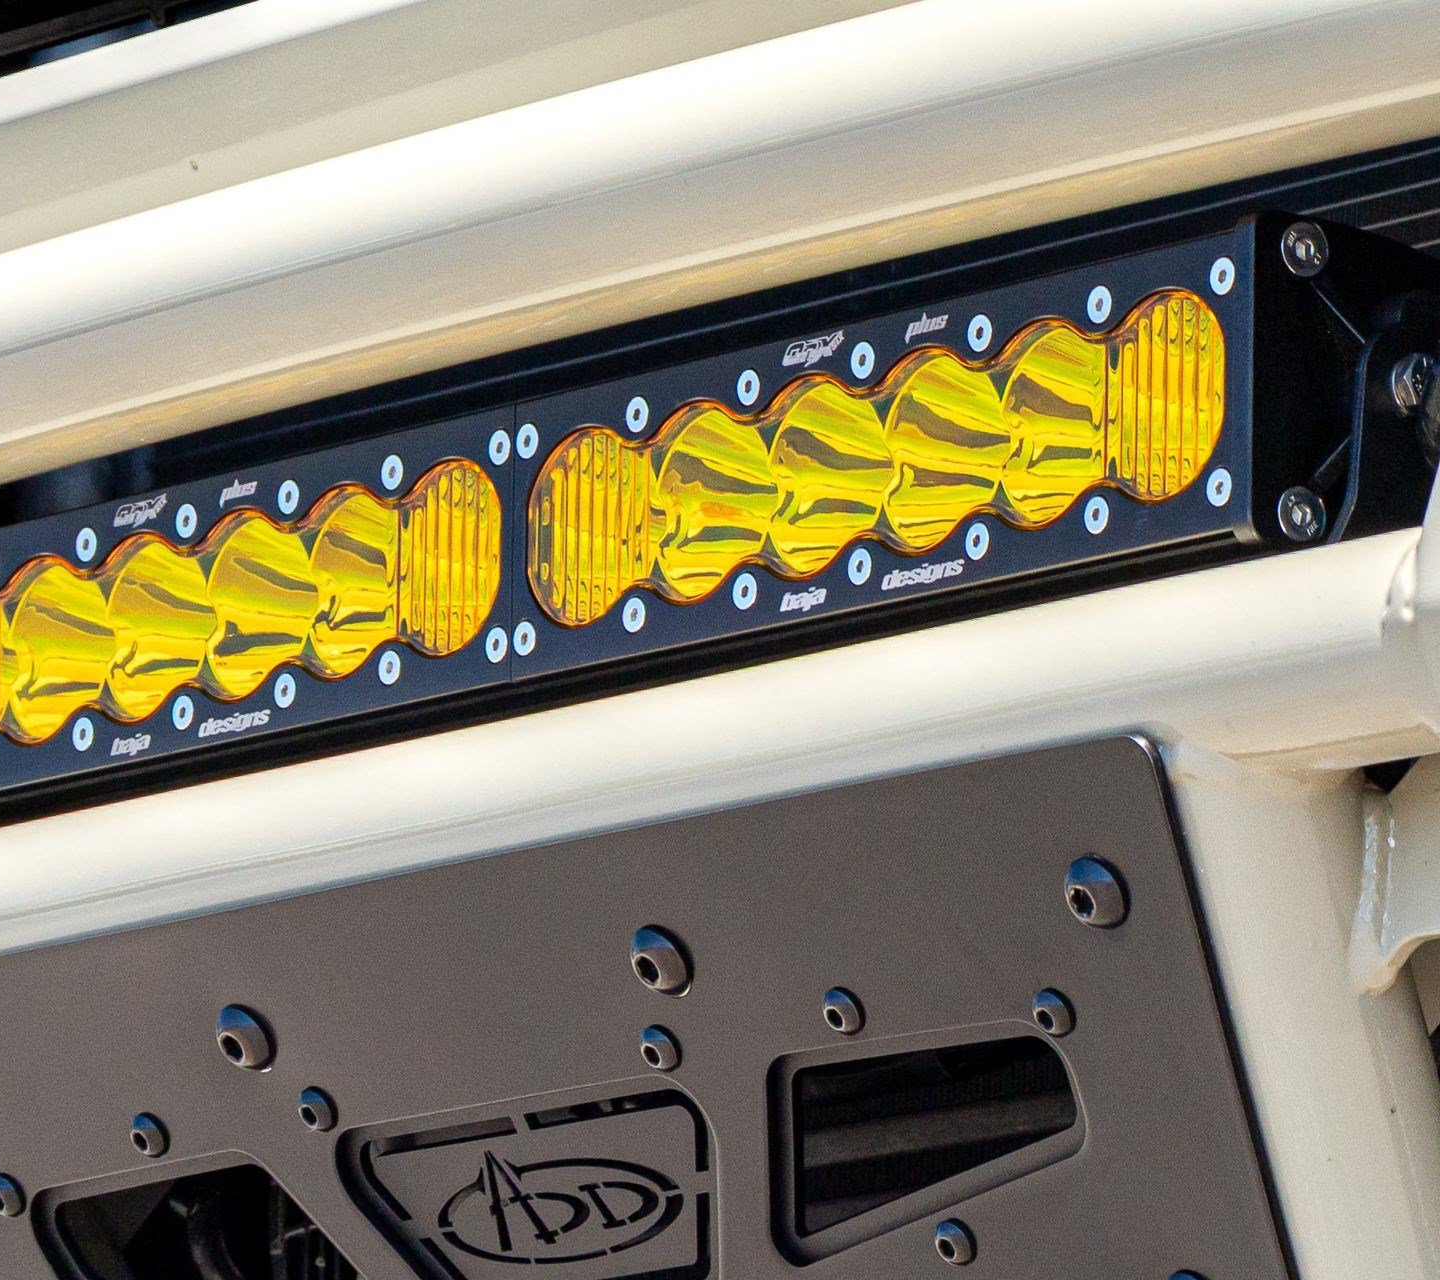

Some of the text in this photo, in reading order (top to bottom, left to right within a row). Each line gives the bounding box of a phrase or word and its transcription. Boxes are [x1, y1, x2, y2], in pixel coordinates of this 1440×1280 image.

[904, 312, 949, 345] plus
[218, 478, 258, 509] plus
[779, 558, 965, 612] baja designs
[110, 709, 272, 757] baja designs
